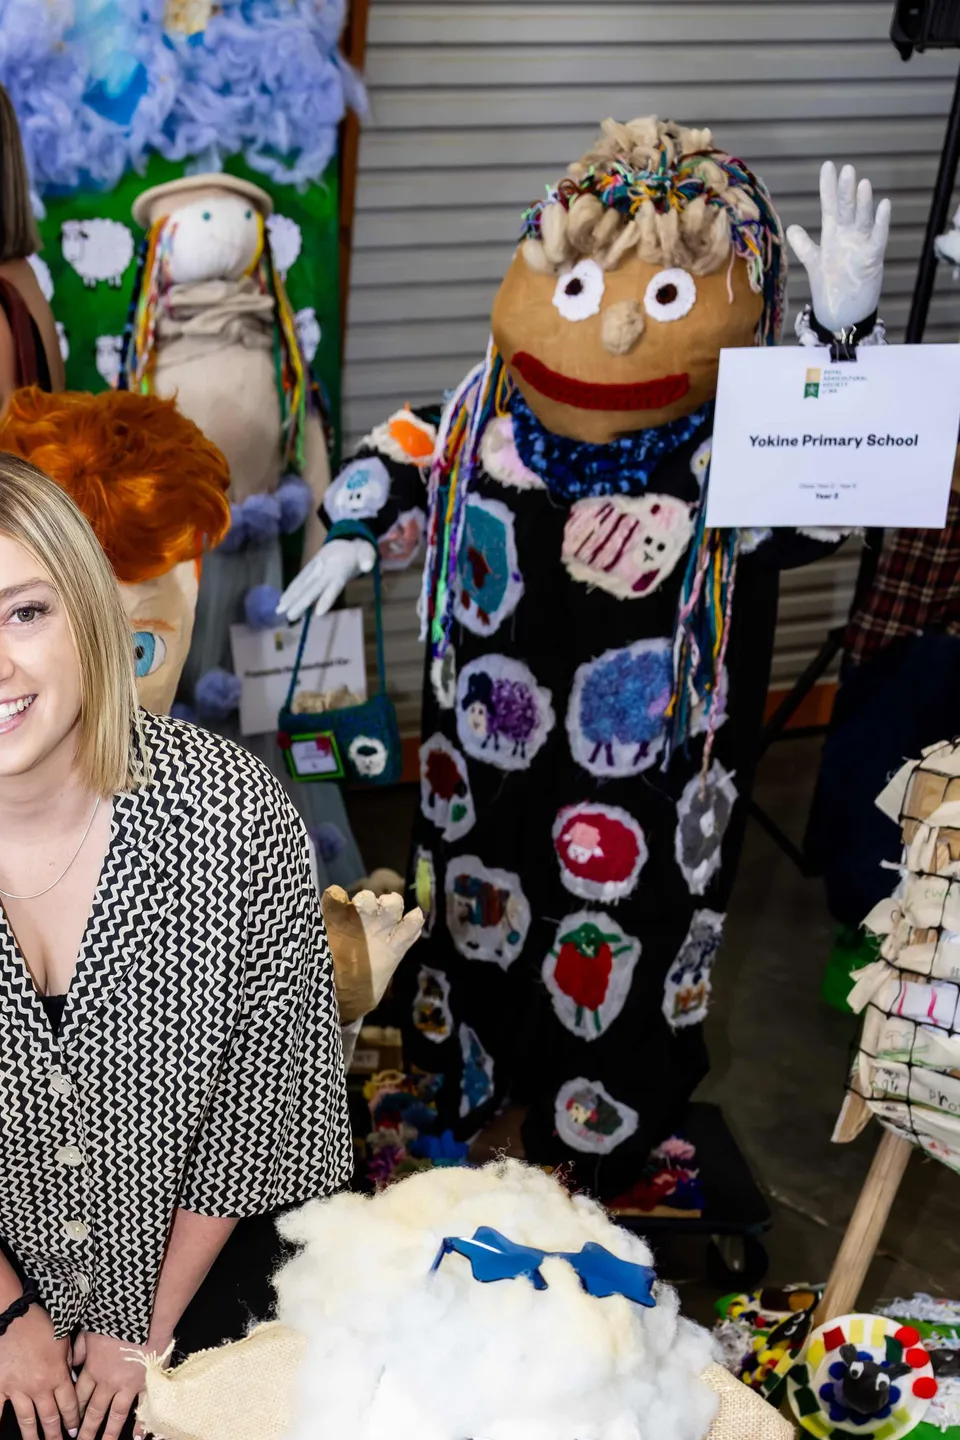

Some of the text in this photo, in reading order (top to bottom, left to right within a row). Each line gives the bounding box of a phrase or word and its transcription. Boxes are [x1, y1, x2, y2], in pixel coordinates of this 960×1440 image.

[749, 434, 919, 449] Yokine Primary School
